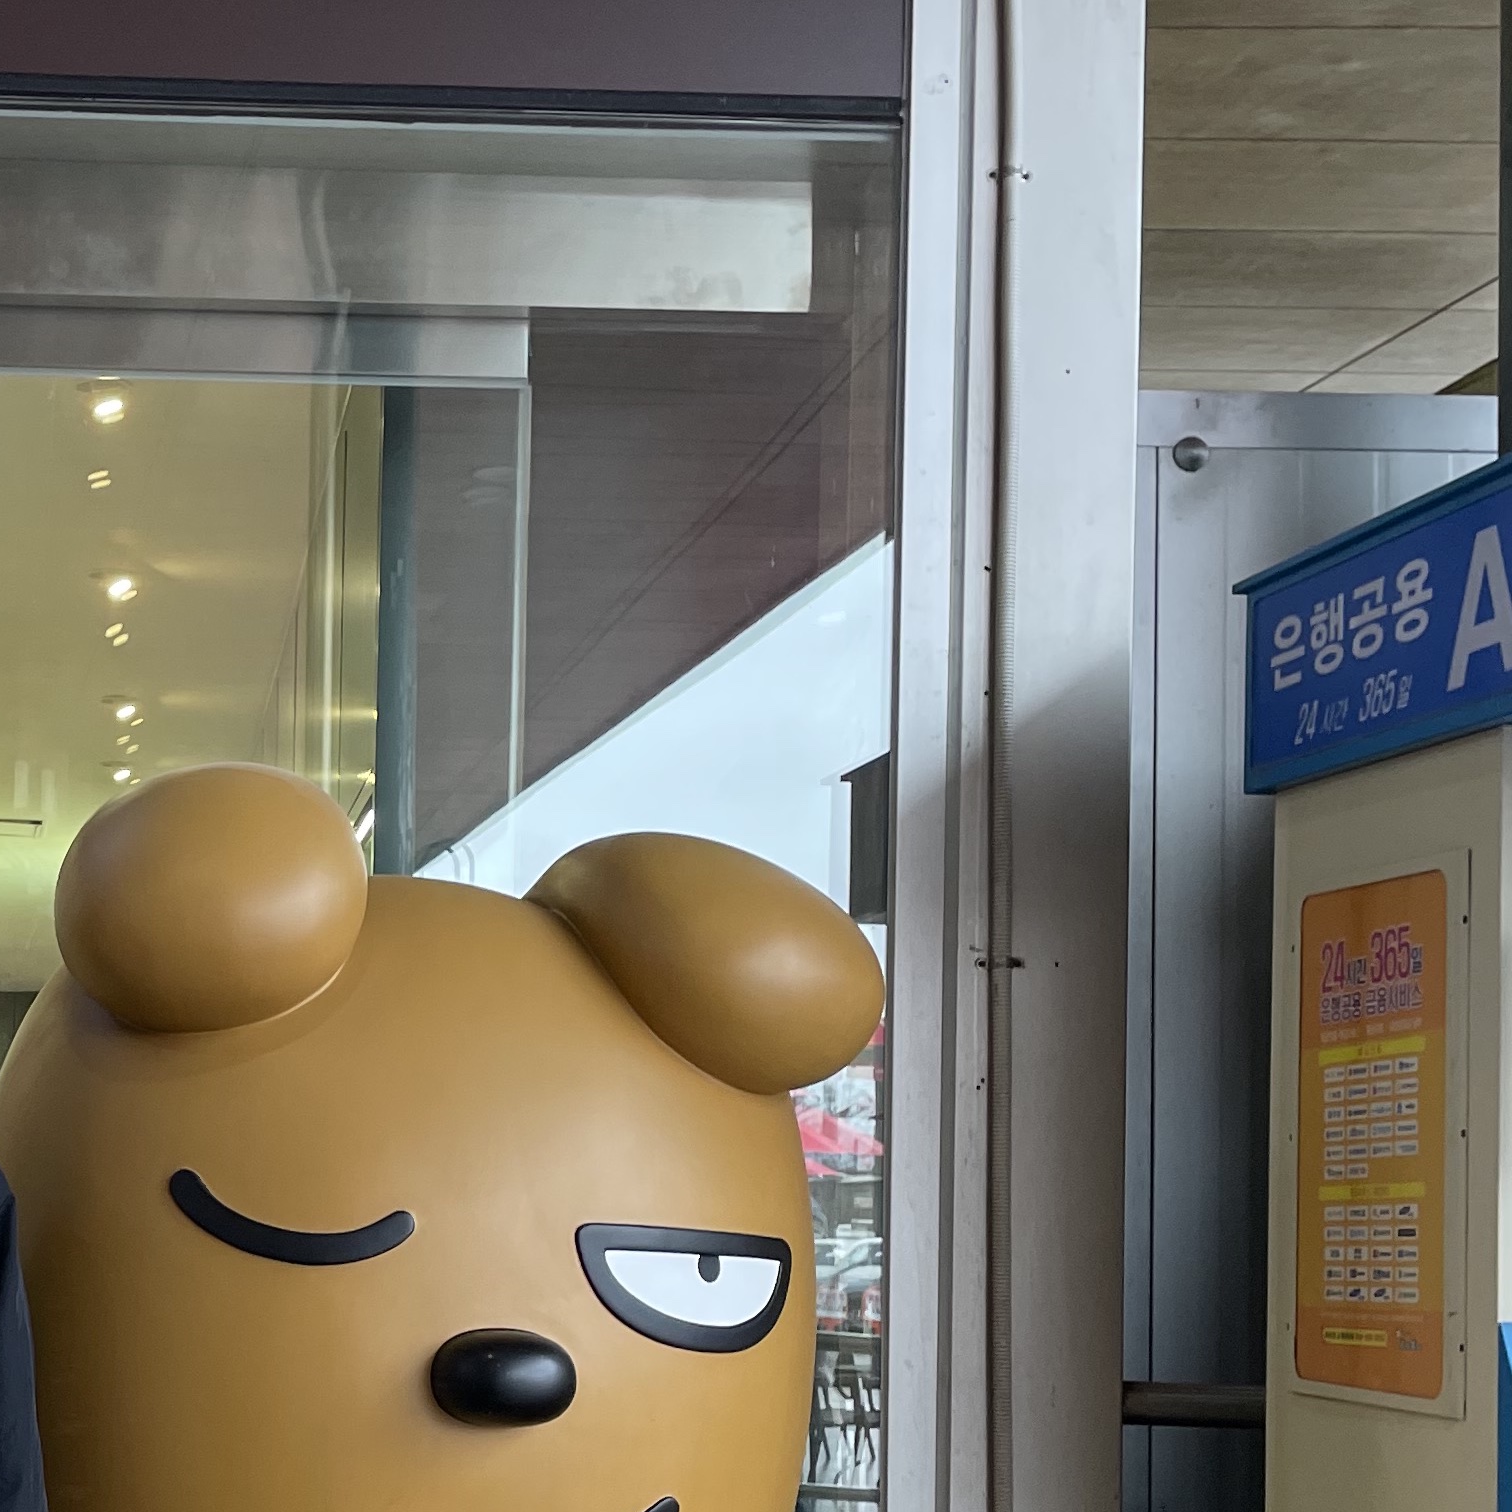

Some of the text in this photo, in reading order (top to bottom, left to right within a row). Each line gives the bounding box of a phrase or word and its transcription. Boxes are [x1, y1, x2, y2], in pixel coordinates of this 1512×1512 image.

[1270, 524, 1512, 693] 은행공용 A
[1369, 924, 1424, 984] 365일
